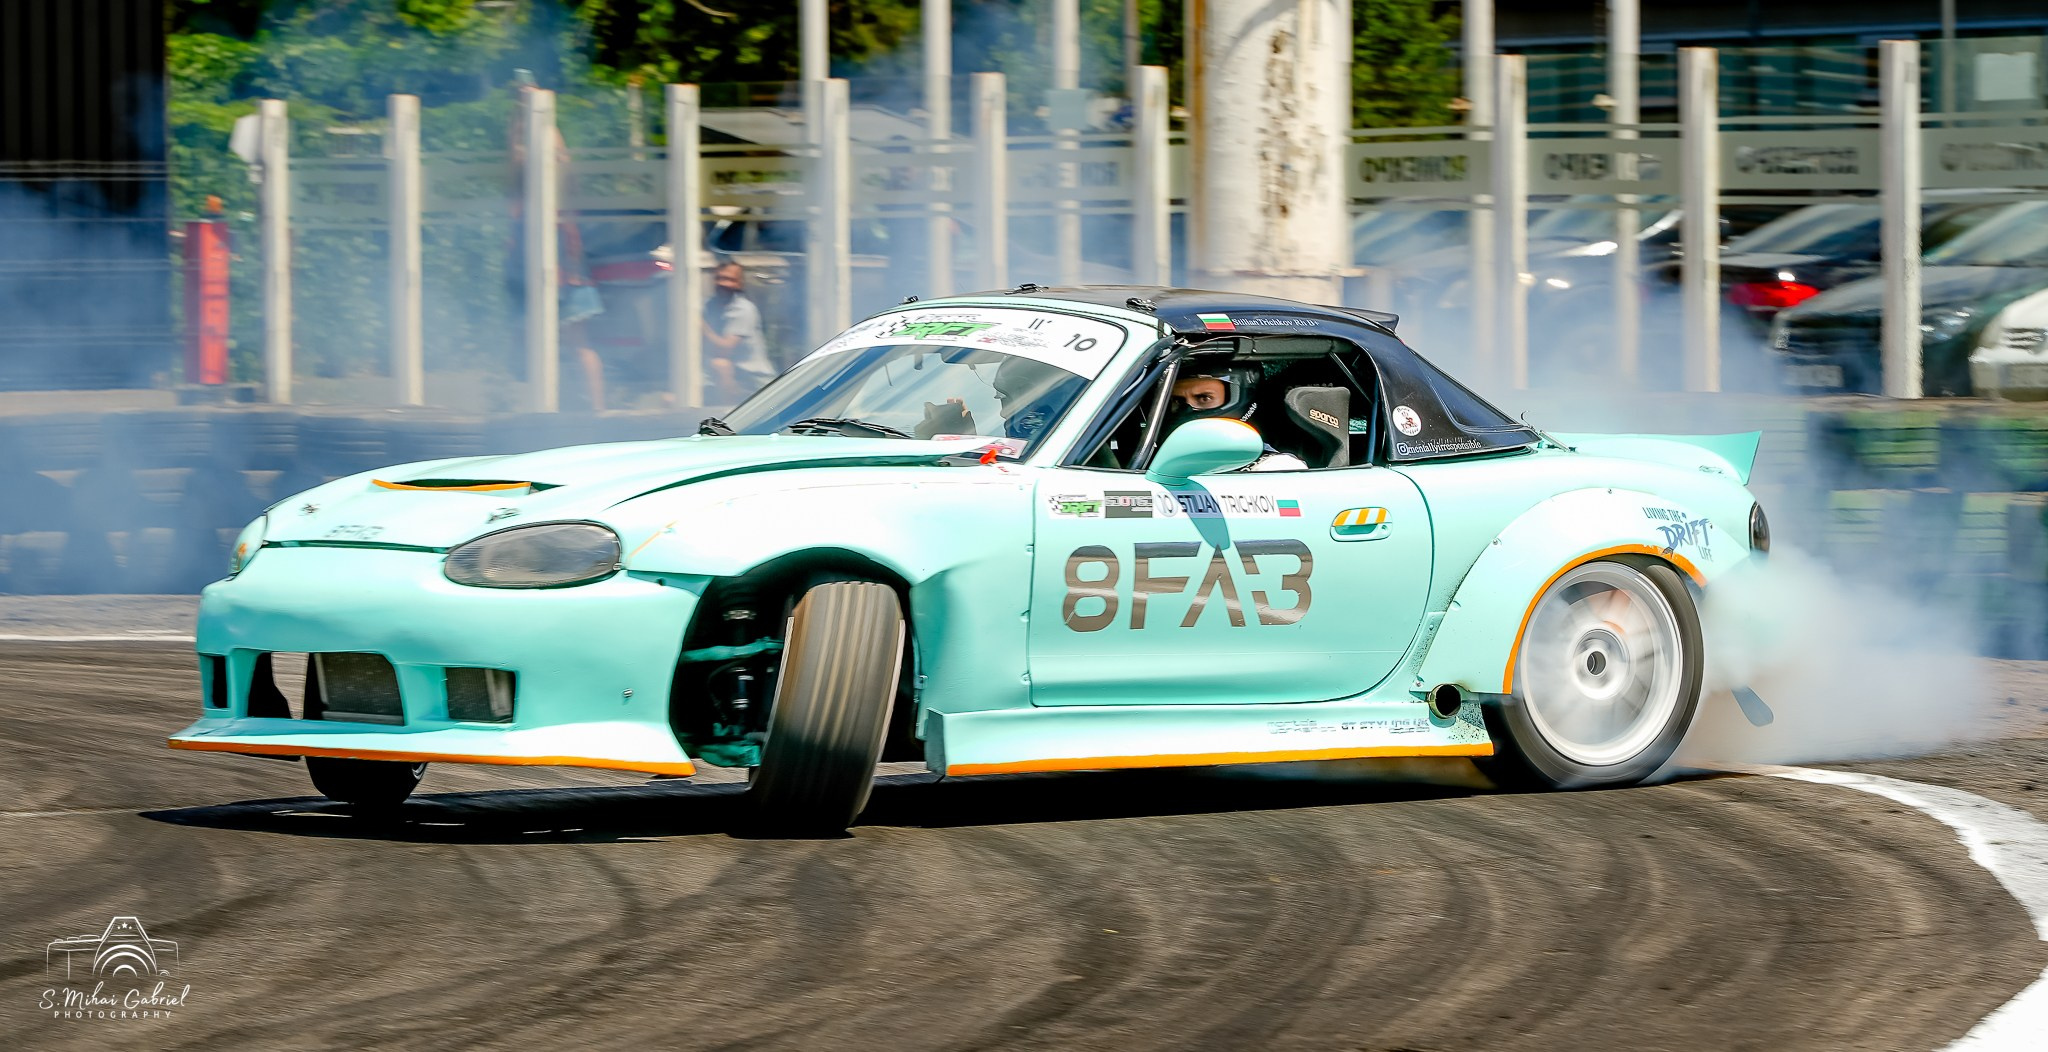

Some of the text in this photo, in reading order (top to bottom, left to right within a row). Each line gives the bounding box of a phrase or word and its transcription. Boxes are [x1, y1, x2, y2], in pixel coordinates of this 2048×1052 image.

[1063, 333, 1097, 351] 10
[1309, 408, 1340, 428] sparco
[1656, 518, 1710, 558] DRIFT
